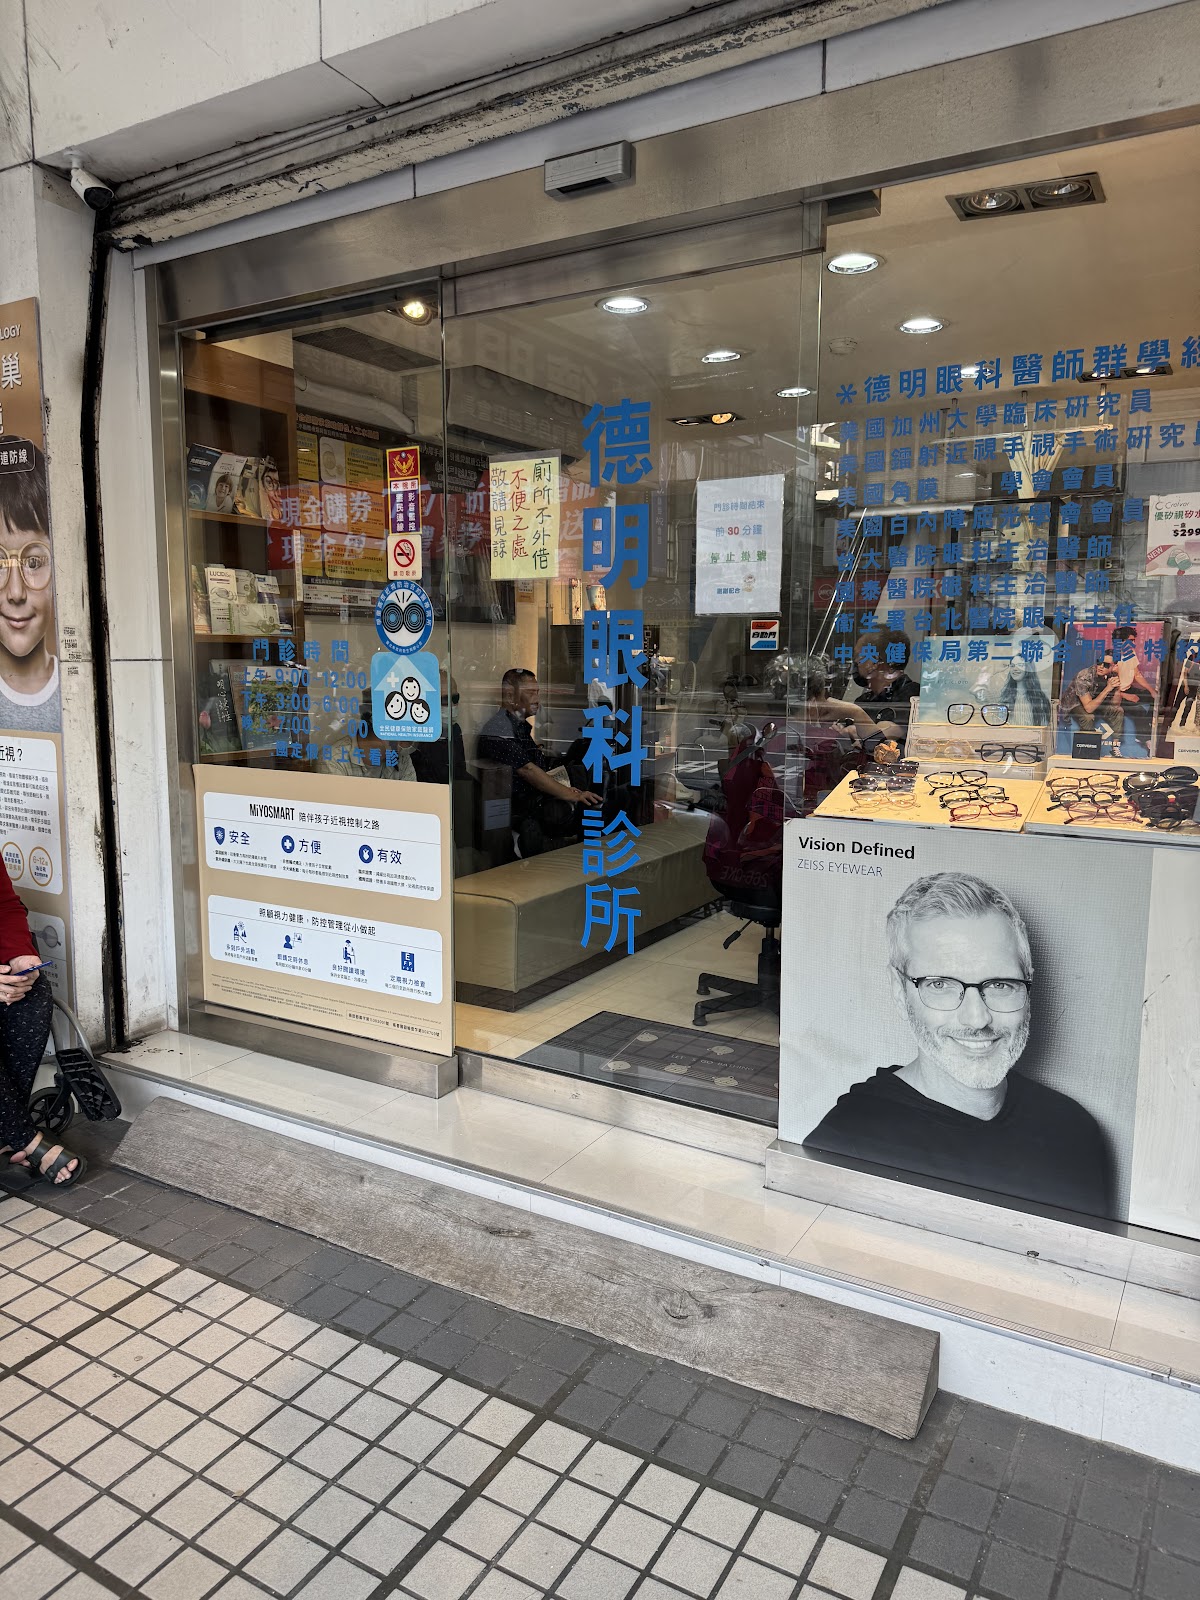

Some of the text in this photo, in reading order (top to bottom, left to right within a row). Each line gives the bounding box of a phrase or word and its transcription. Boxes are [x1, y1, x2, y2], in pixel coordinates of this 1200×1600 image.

[1, 352, 22, 389] 巢
[839, 389, 1152, 443] 美國加州大學臨床研究員
[490, 467, 510, 560] 敬請見諒
[508, 469, 531, 561] 不便之處
[532, 459, 552, 571] 廁所不外借
[713, 500, 766, 512] 門診時間結束
[837, 497, 1145, 540] 美國白內障屈光學會會員
[715, 525, 763, 537] 前 30 分鐘
[836, 534, 1113, 572] 台大醫院眼科主治醫師
[1147, 546, 1163, 561] NEW
[835, 571, 1110, 603] 國泰醫院眼科主治醫師
[834, 604, 1138, 633] 衛生署台北醫院眼科主任
[253, 639, 350, 664] 門診時間
[834, 638, 1200, 664] 中央健保局第二聯合門診特約
[240, 667, 266, 685] 上午
[580, 398, 653, 954] 德明眼科診所
[240, 690, 267, 709] 下午
[250, 803, 380, 831] MiYOSMART 陪伴孩子近視控制之路
[229, 830, 250, 846] 安全
[298, 838, 322, 855] 方便
[798, 836, 915, 860] Vision Defined
[377, 848, 402, 865] 有效
[797, 859, 883, 877] ZEISS EYEWEAR
